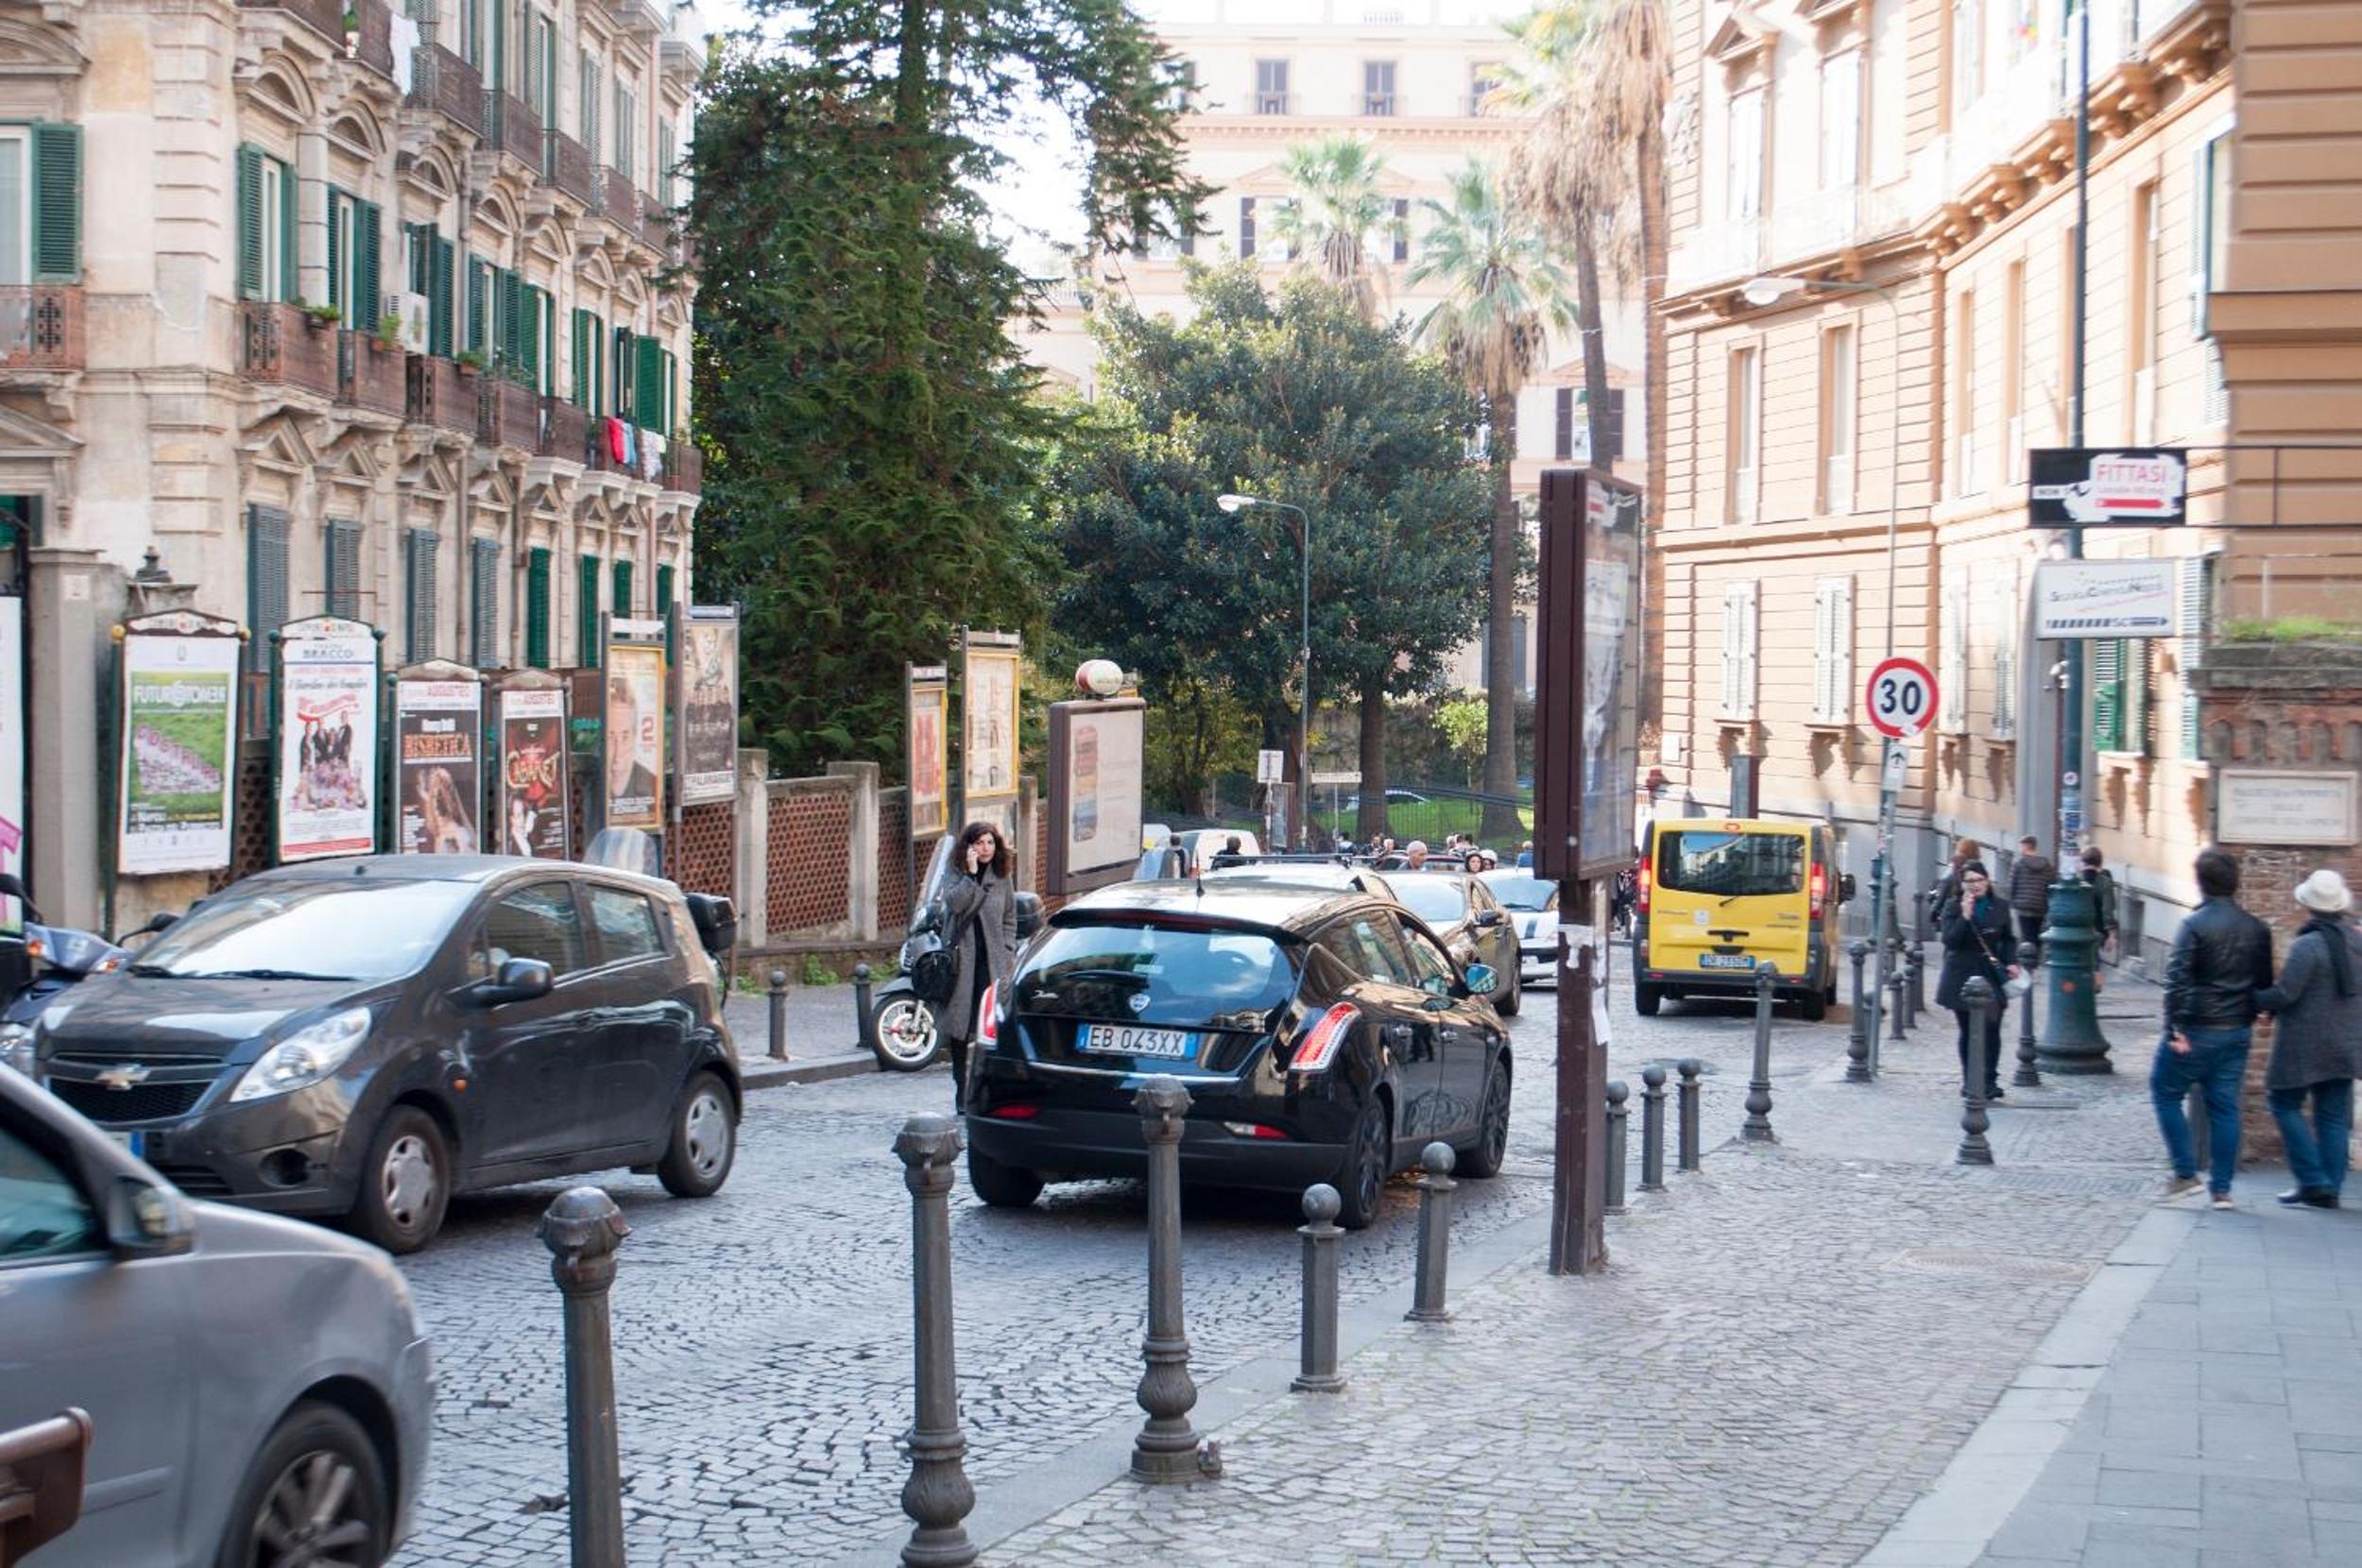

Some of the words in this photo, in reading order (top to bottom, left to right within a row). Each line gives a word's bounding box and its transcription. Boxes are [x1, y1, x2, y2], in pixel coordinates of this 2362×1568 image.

[2097, 463, 2166, 484] FITTASI
[1880, 677, 1922, 715] 30
[1089, 1027, 1114, 1048] EB
[1120, 1030, 1183, 1054] 043XX
